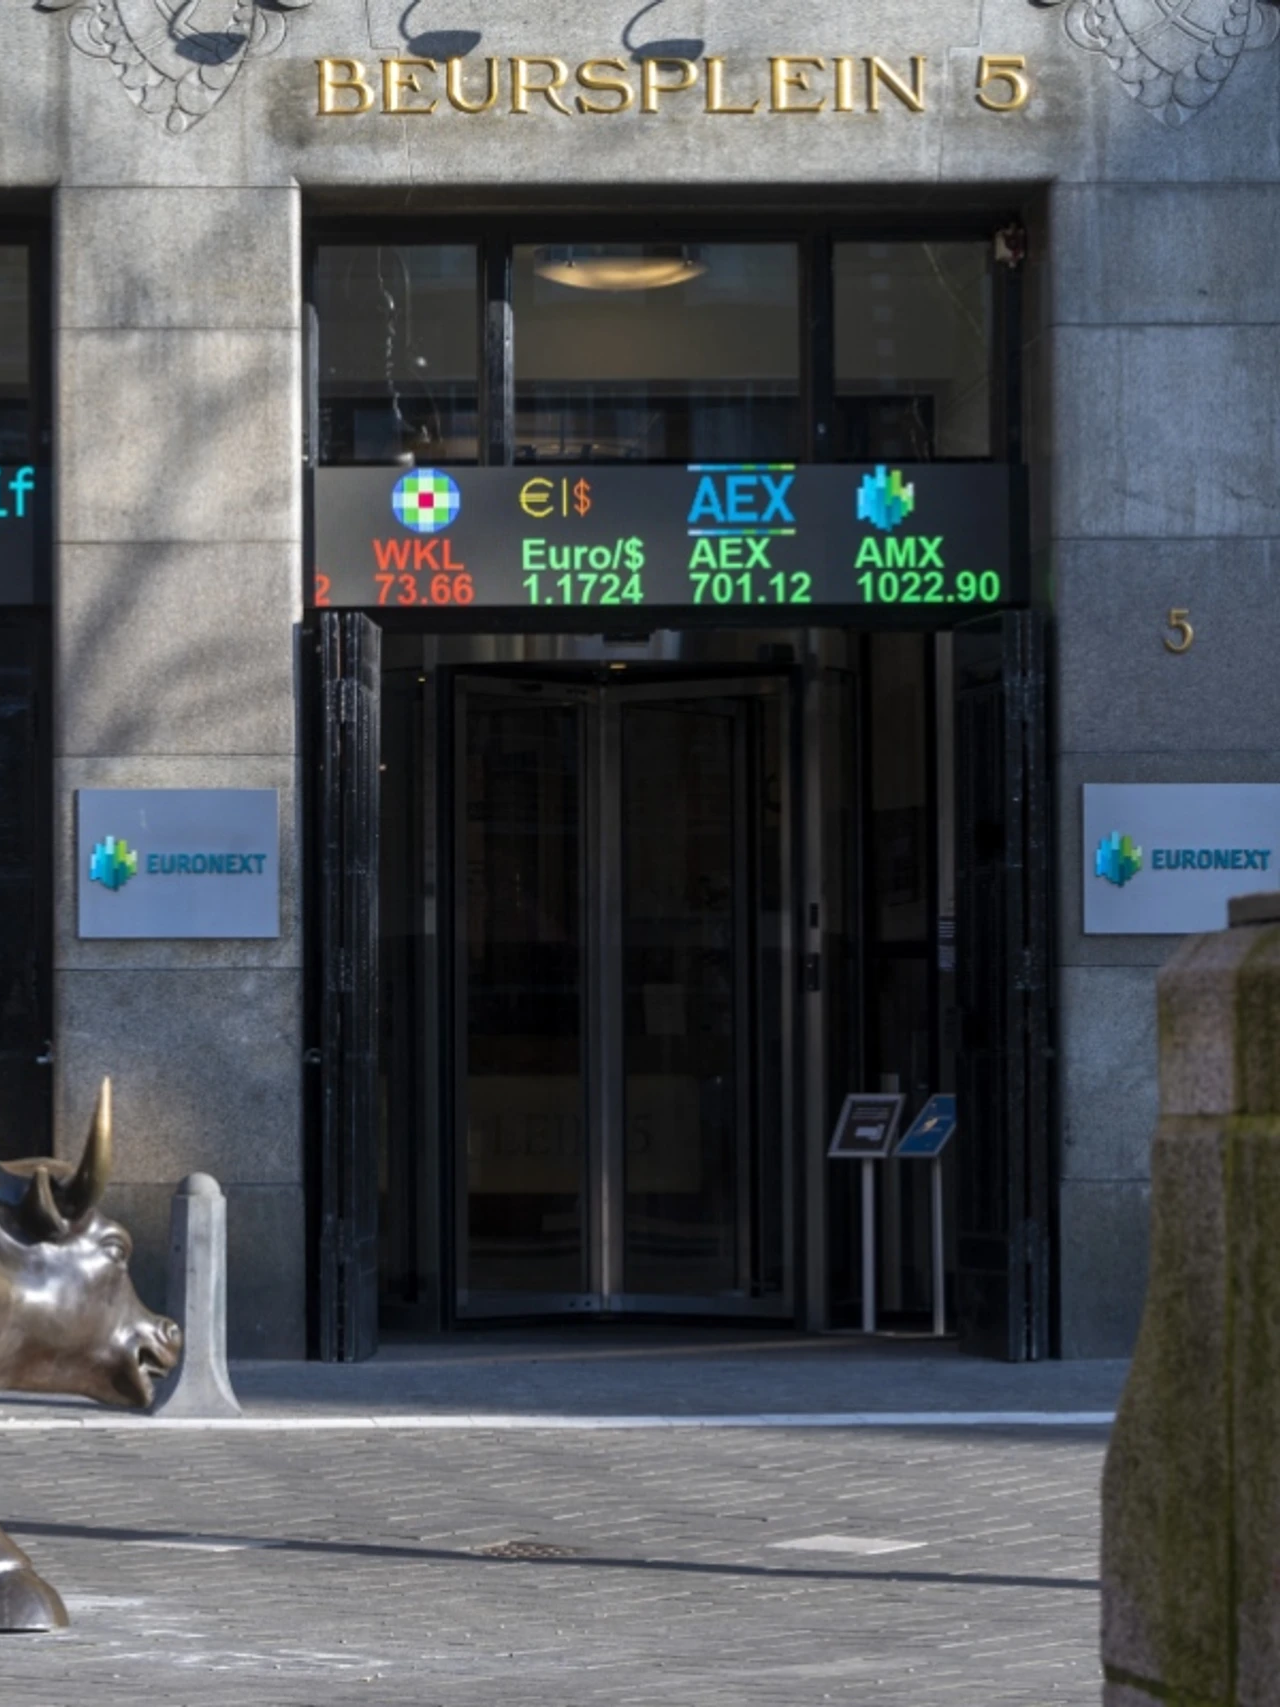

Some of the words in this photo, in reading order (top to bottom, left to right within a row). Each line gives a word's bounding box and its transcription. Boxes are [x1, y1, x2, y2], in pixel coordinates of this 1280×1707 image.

[314, 56, 926, 116] BEURSPLEIN
[974, 56, 1029, 112] 5
[687, 475, 795, 522] AEX
[373, 538, 464, 571] WKL
[522, 536, 645, 572] Euro/$
[688, 537, 771, 570] AEX
[854, 536, 944, 569] AMX
[374, 573, 474, 606] 73.66
[522, 573, 644, 605] 1.1724
[689, 572, 811, 603] 701.12
[857, 571, 1001, 603] 1022.90
[1163, 607, 1195, 655] 5
[146, 853, 268, 875] EURONEXT
[1151, 848, 1273, 872] EURONEXT
